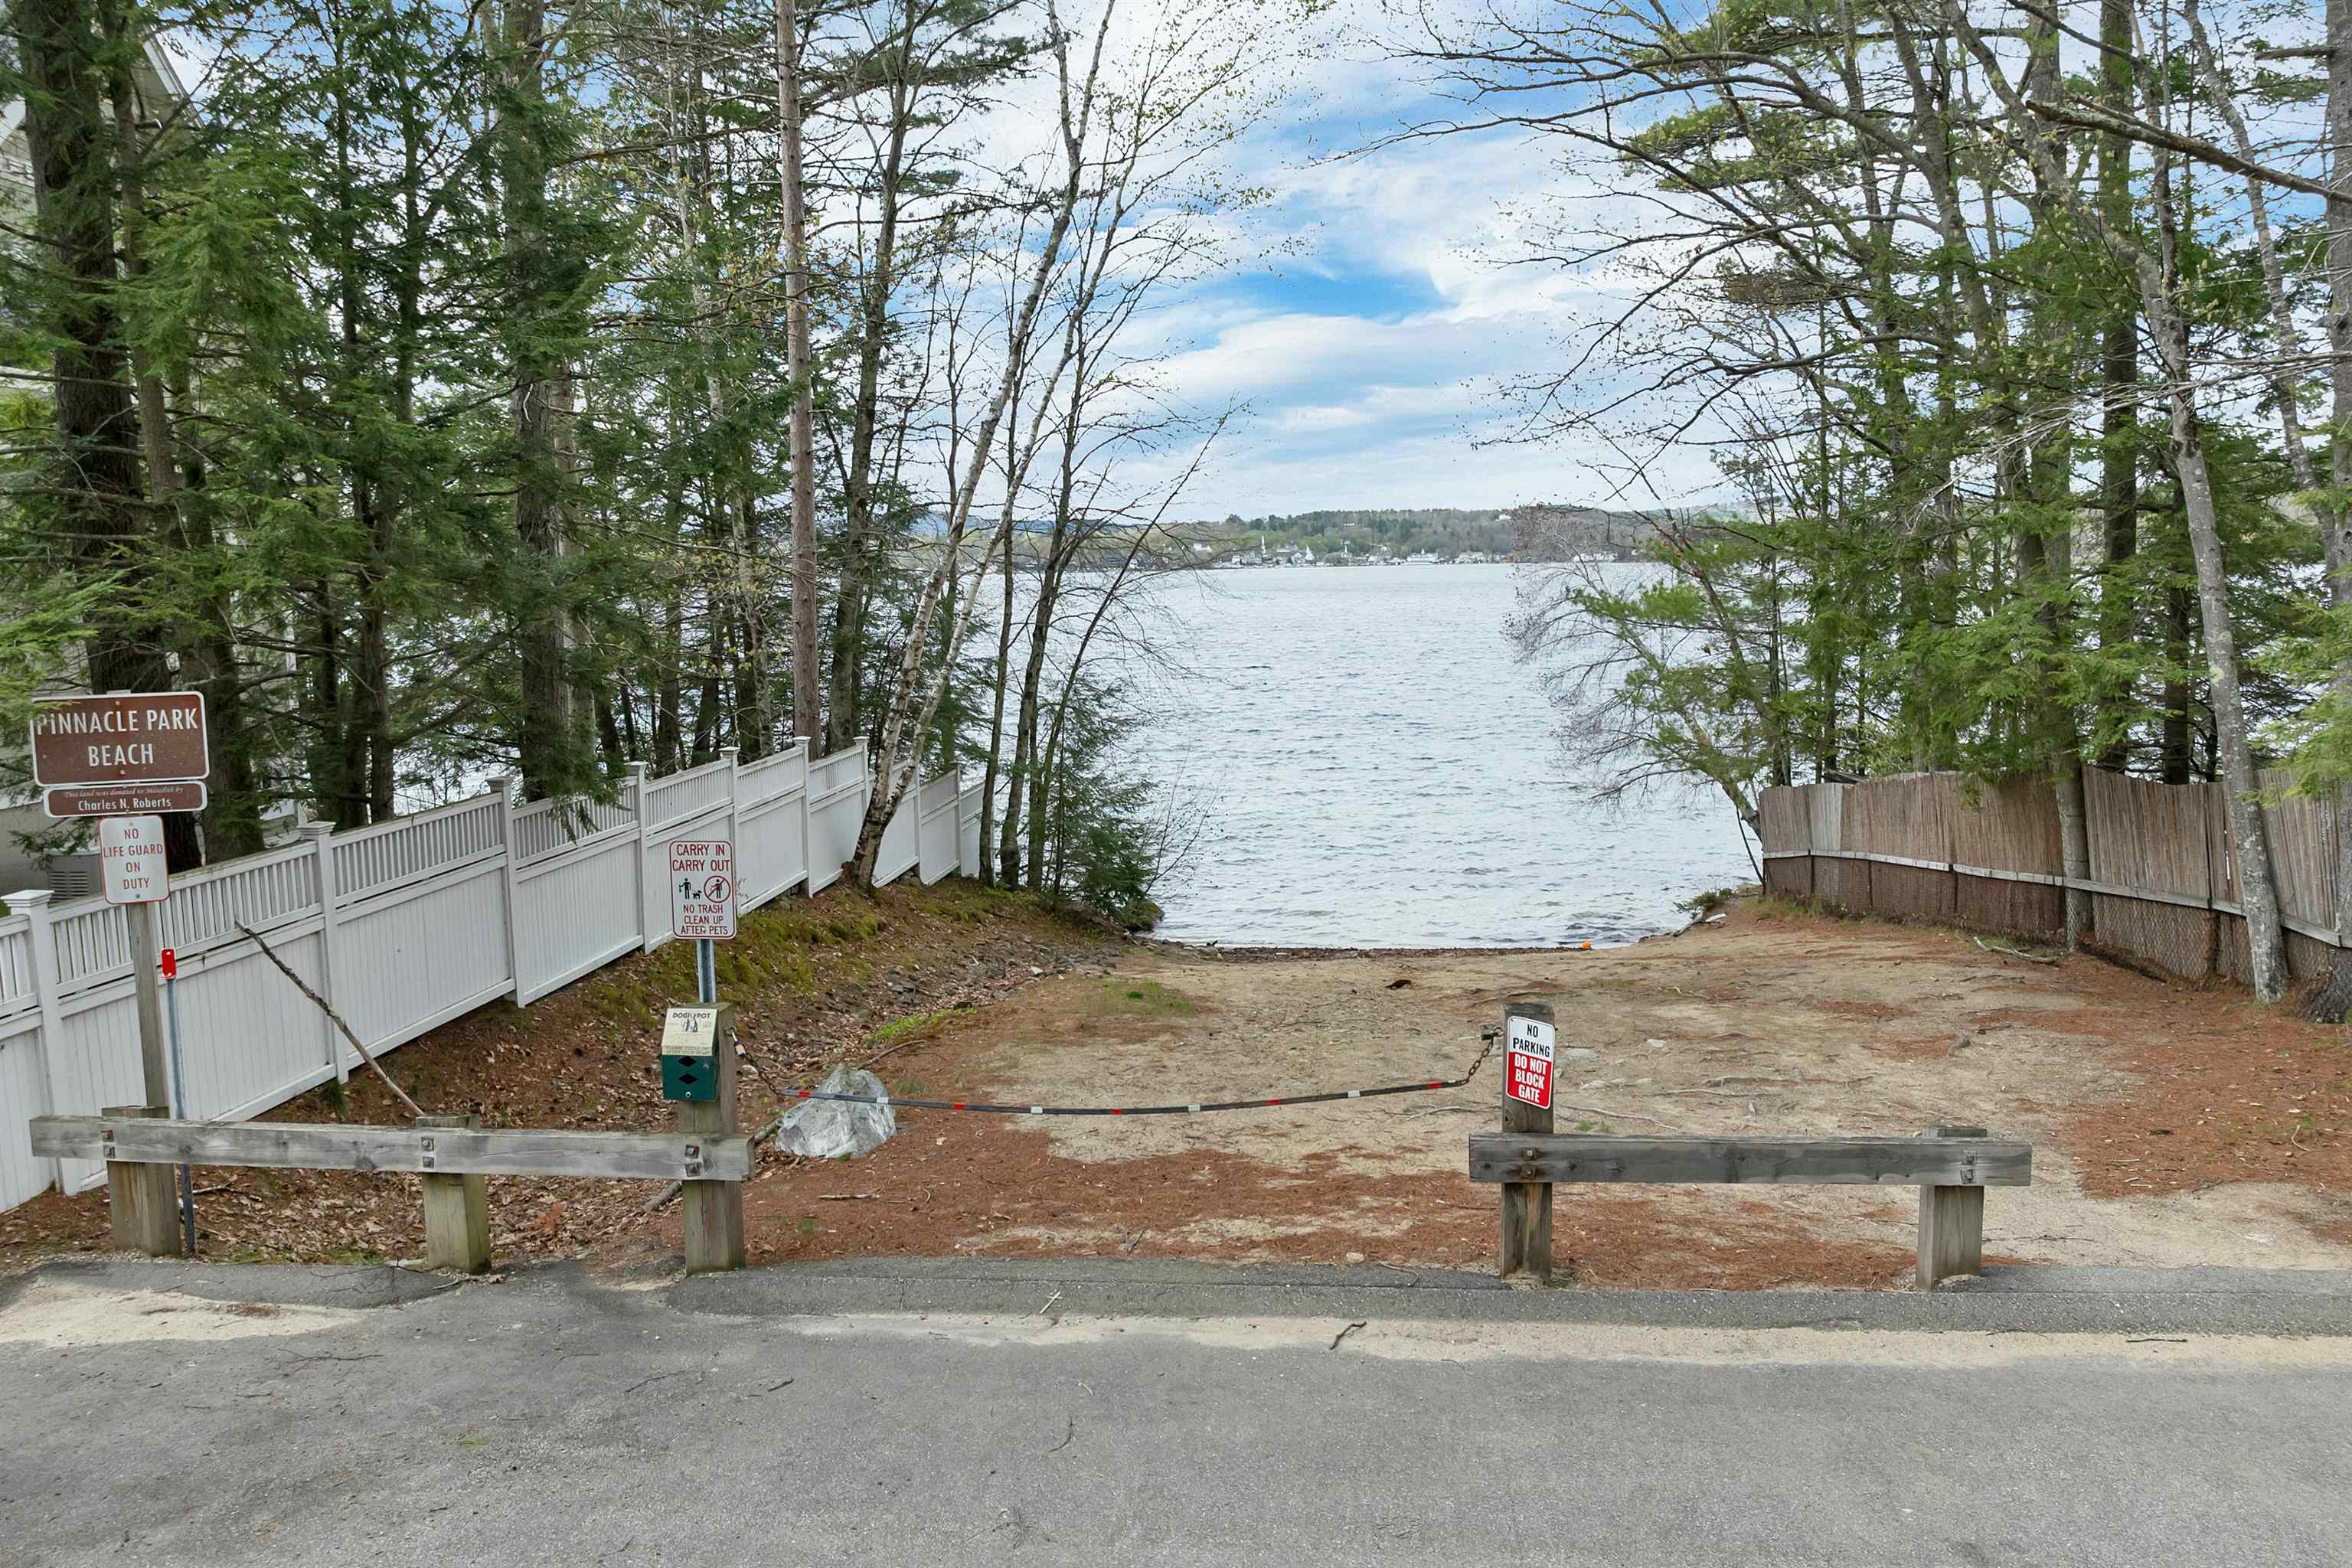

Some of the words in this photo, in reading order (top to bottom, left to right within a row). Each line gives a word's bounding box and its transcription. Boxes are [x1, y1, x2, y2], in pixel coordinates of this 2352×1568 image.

[37, 710, 139, 735] PINNACLE
[147, 708, 198, 730] PARK
[88, 743, 155, 766] BEACH
[78, 799, 116, 811] Charles
[119, 798, 130, 809] N.
[133, 797, 172, 808] Roberts
[124, 828, 139, 840] NO
[103, 846, 125, 858] LIFE
[129, 844, 163, 856] GUARD
[677, 844, 710, 856] CARRY
[715, 844, 725, 856] IN
[126, 862, 141, 873] ON
[672, 860, 705, 871] CARRY
[710, 859, 730, 871] OUT
[123, 877, 150, 890] DUTY
[684, 904, 694, 913] NO
[698, 904, 724, 913] TRASH
[684, 915, 709, 925] CLEAN
[714, 915, 724, 925] UP
[681, 926, 706, 935] AFTER
[709, 926, 728, 935] PETS
[1527, 1024, 1538, 1037] NO
[1513, 1037, 1550, 1057] PARKING
[1514, 1054, 1527, 1070] DO
[1530, 1057, 1547, 1075] NOT
[1515, 1068, 1545, 1089] BLOCK
[1518, 1084, 1540, 1102] GATE
